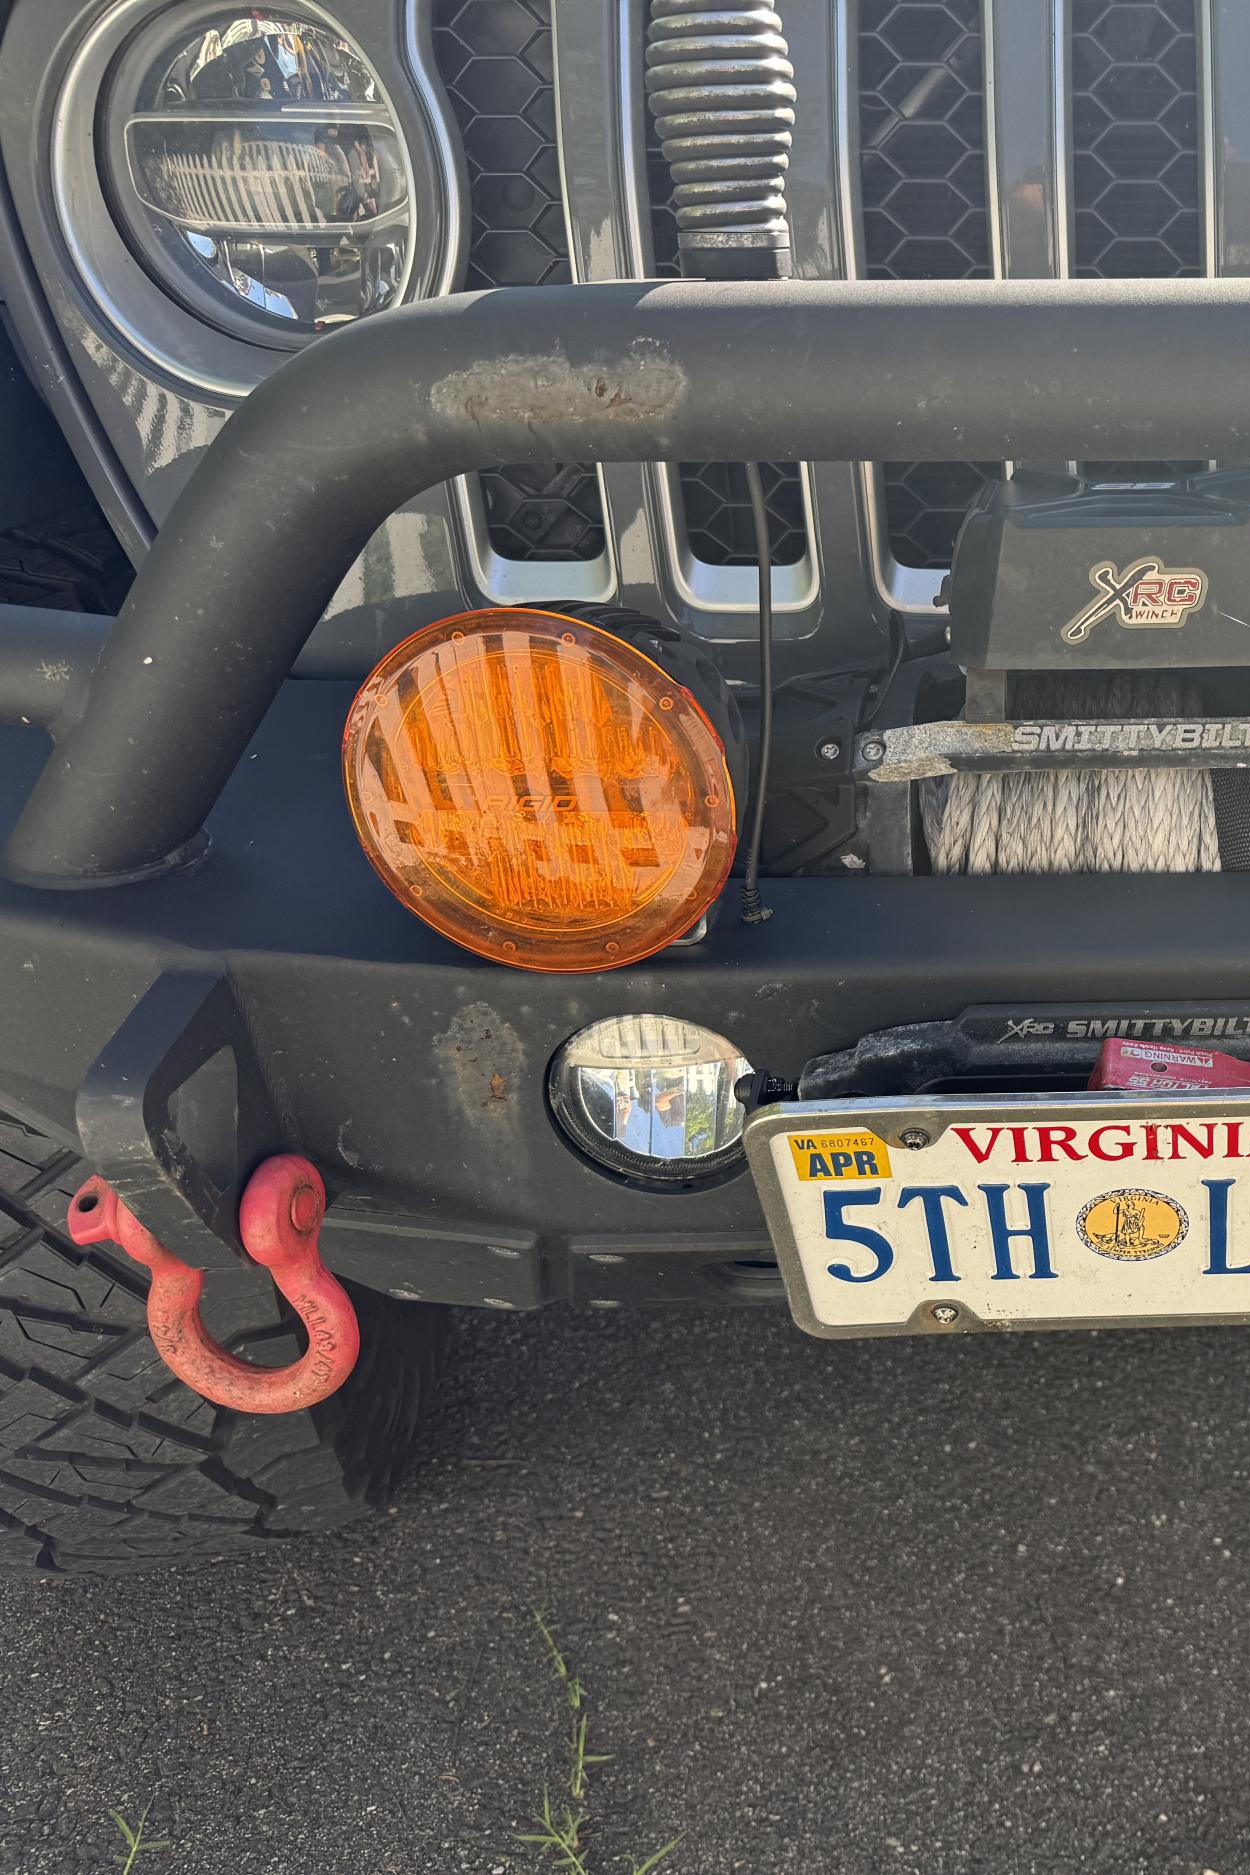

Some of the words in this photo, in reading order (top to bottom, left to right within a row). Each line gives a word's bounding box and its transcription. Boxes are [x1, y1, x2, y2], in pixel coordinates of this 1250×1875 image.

[1067, 562, 1201, 640] XRC
[1134, 609, 1180, 620] WINCH
[998, 1018, 1055, 1043] XRC
[1144, 1050, 1200, 1065] WARNING
[794, 1139, 818, 1150] VA
[821, 1137, 874, 1149] 6807467
[809, 1151, 879, 1178] APR
[1110, 1196, 1160, 1206] VIRGINIA
[822, 1182, 1059, 1283] 5TH
